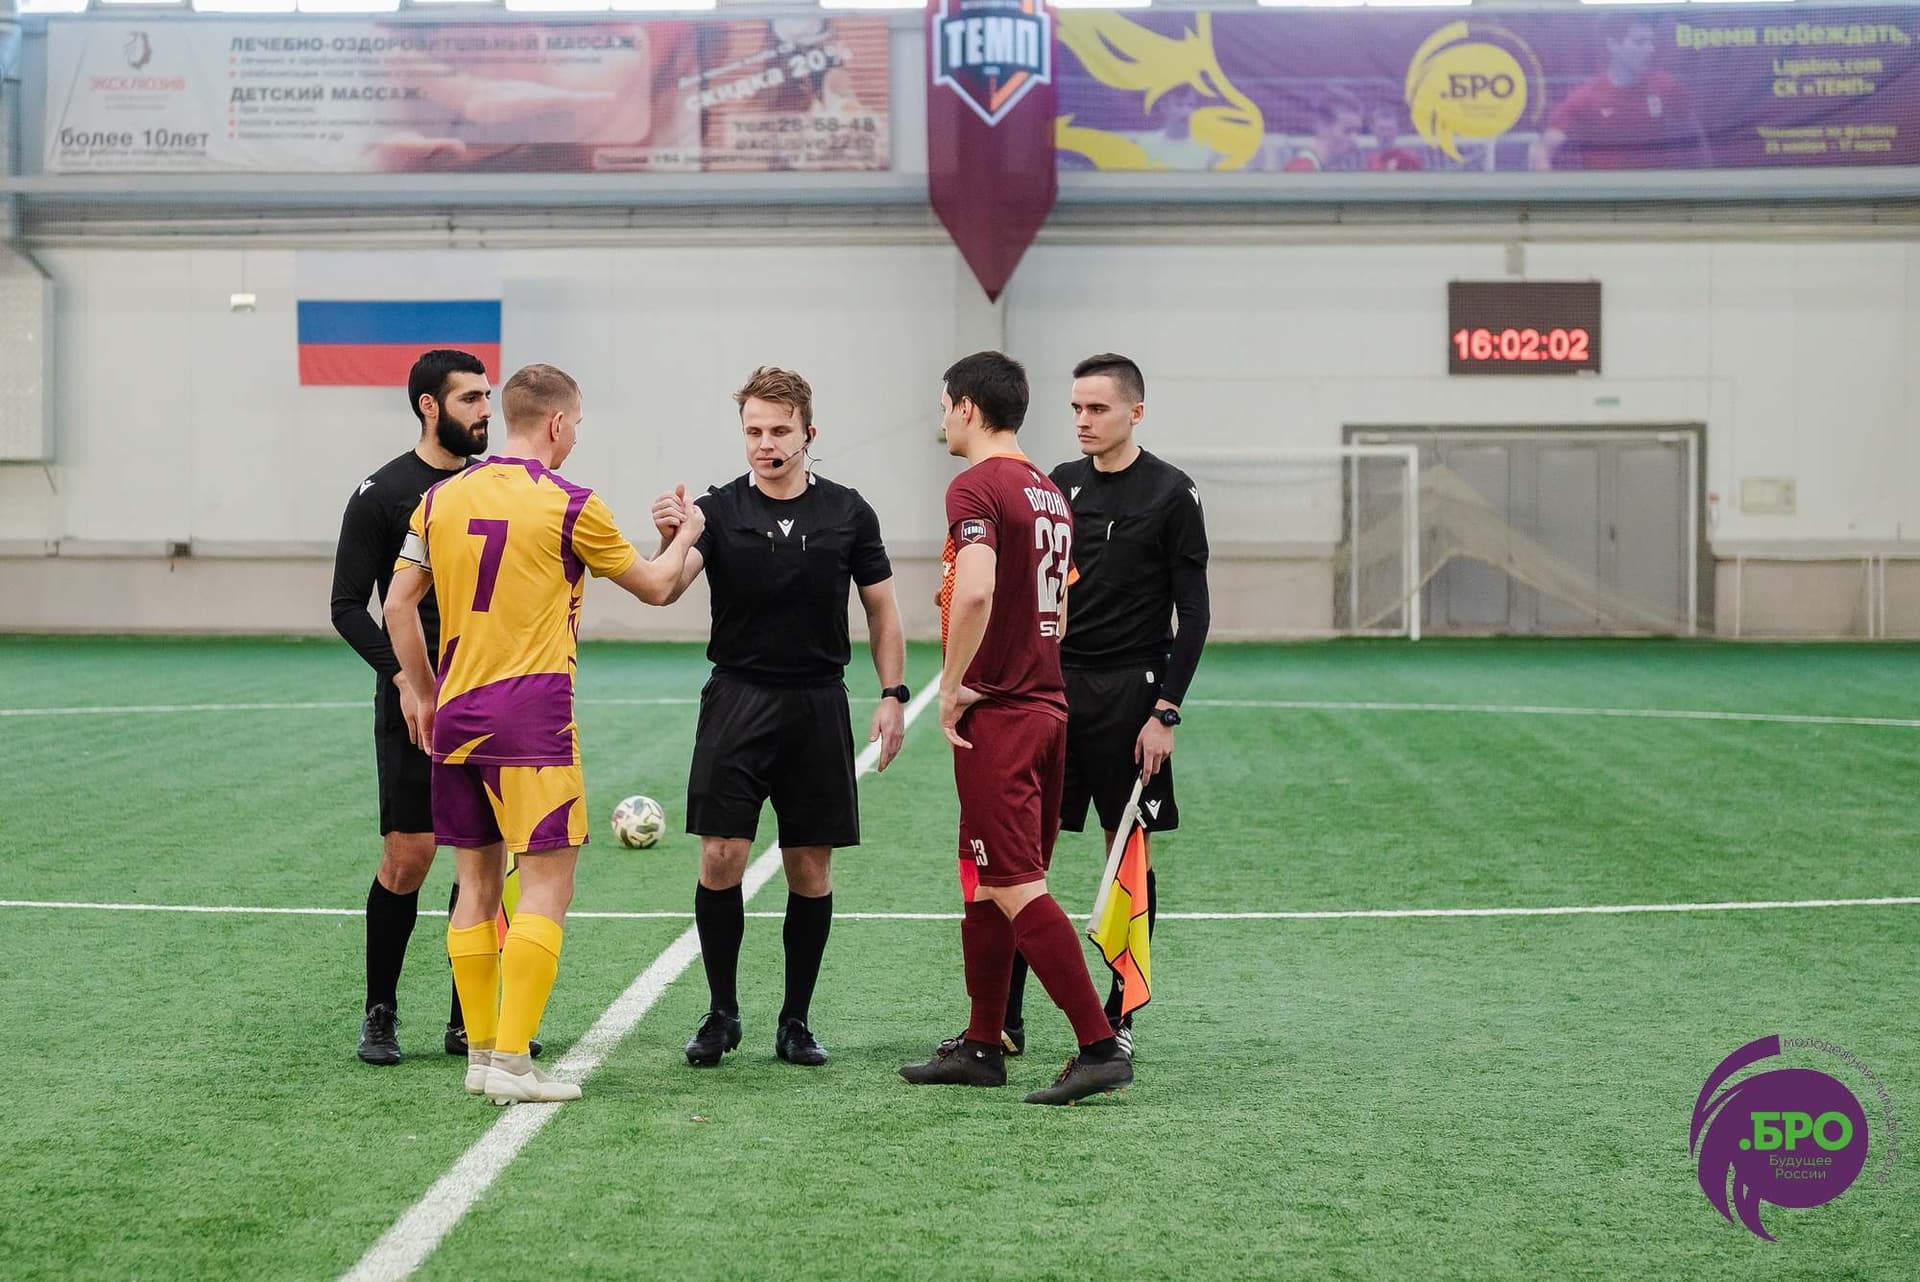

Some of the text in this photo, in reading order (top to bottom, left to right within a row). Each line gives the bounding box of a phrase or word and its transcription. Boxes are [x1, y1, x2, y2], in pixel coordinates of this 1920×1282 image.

[943, 16, 1039, 67] ТЕМП
[1676, 25, 1756, 50] Время
[231, 84, 324, 103] ДЕТСКИЙ
[1440, 73, 1516, 99] .БРО
[61, 126, 133, 147] более
[1454, 328, 1589, 360] 16:02:02
[963, 525, 983, 536] ТЕМП
[467, 518, 509, 612] 7
